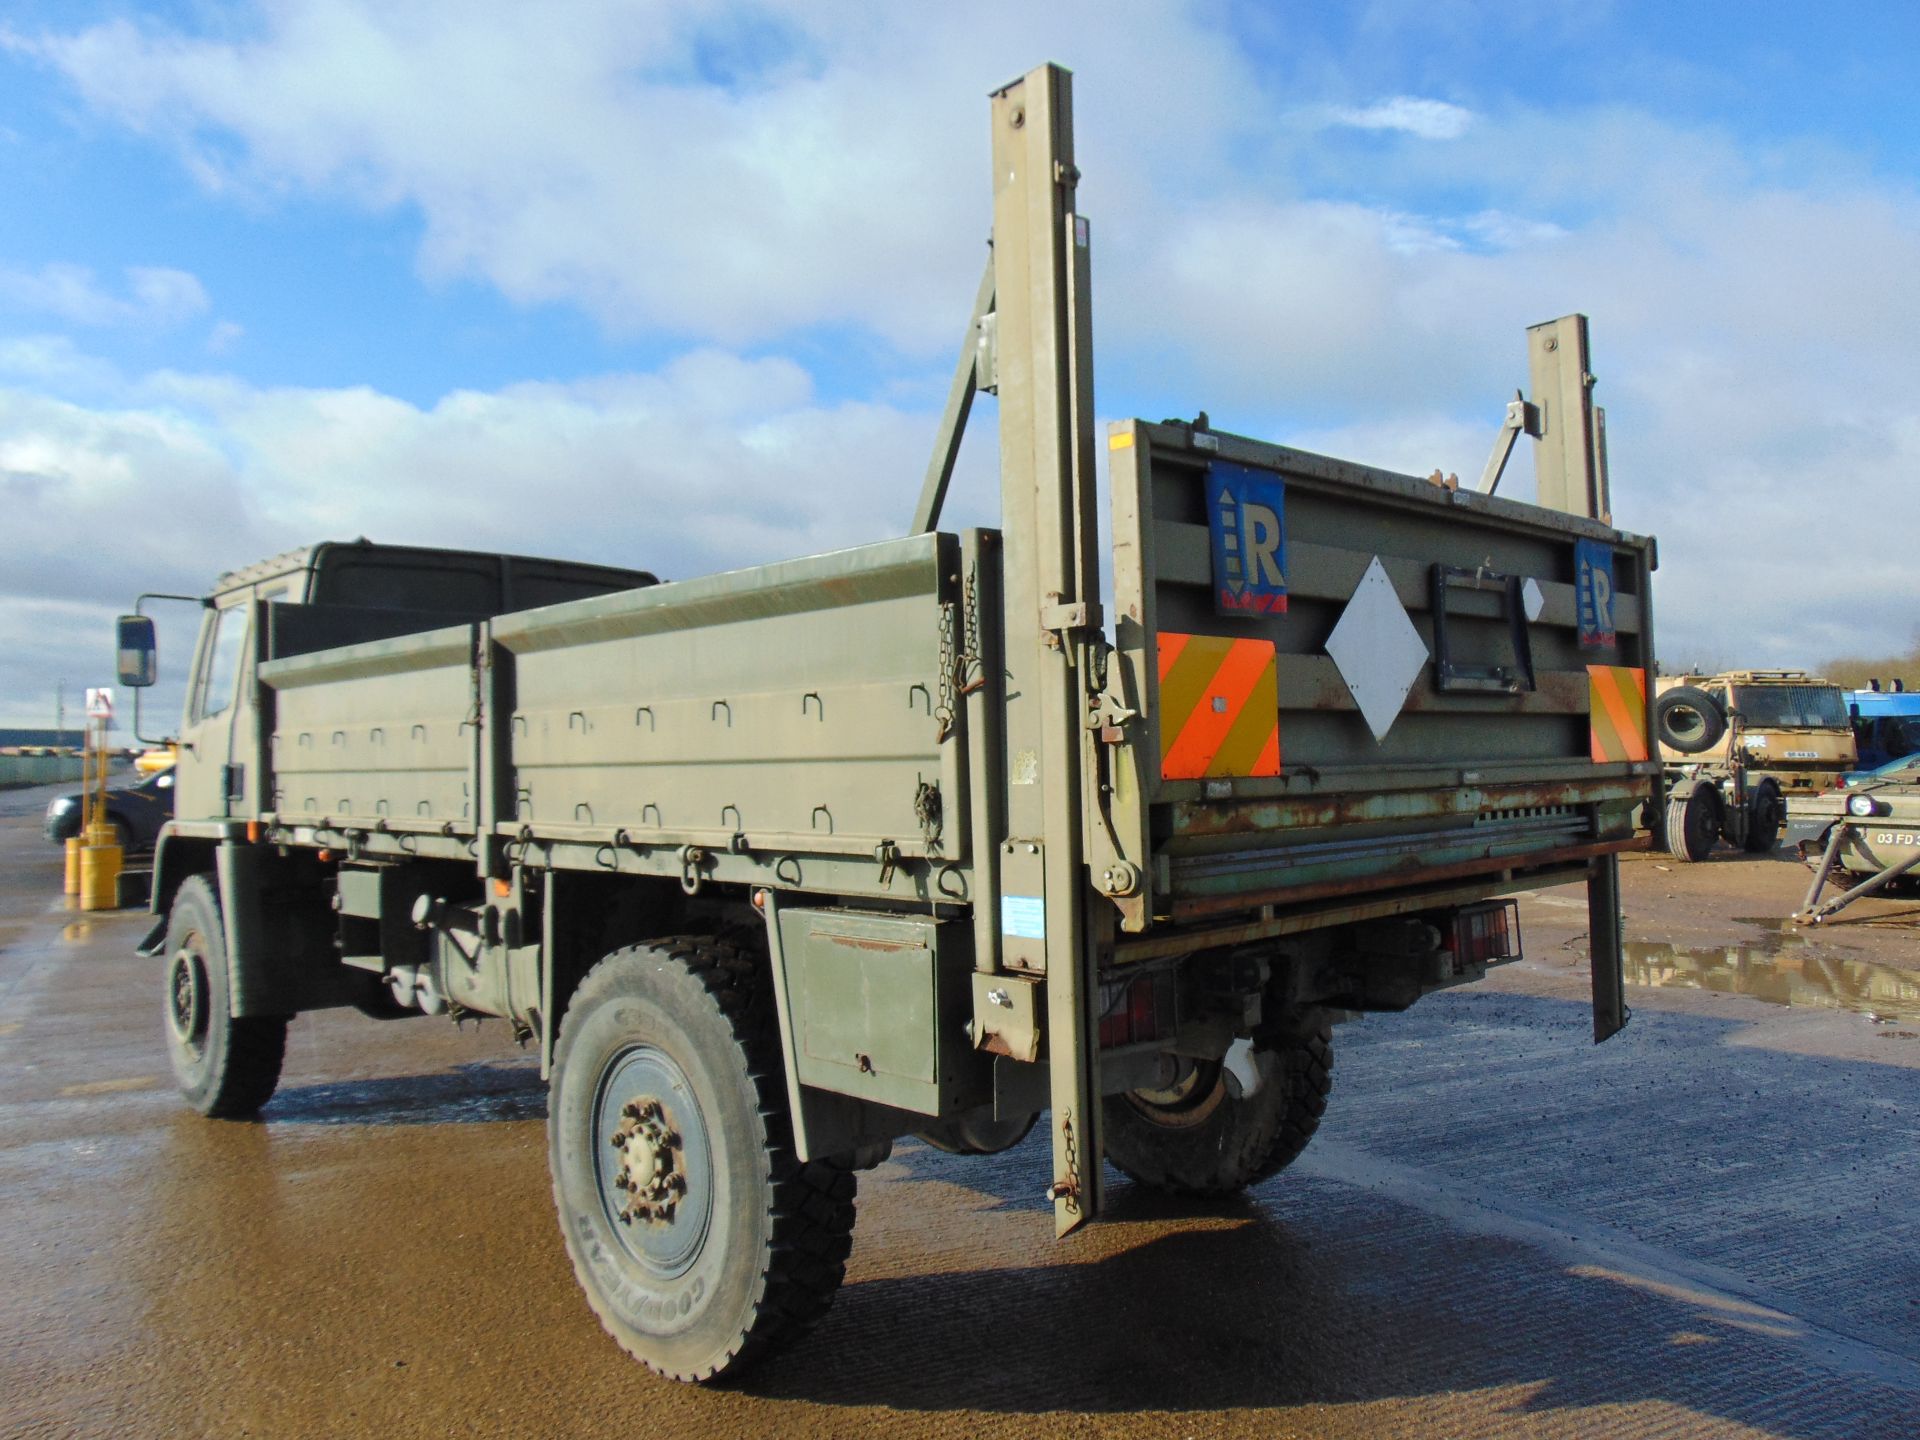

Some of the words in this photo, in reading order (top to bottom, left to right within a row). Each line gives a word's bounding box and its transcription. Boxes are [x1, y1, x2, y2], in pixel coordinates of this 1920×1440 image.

[1242, 502, 1286, 587] R
[1592, 568, 1613, 628] R
[1877, 833, 1893, 844] 03
[1896, 833, 1914, 845] FD
